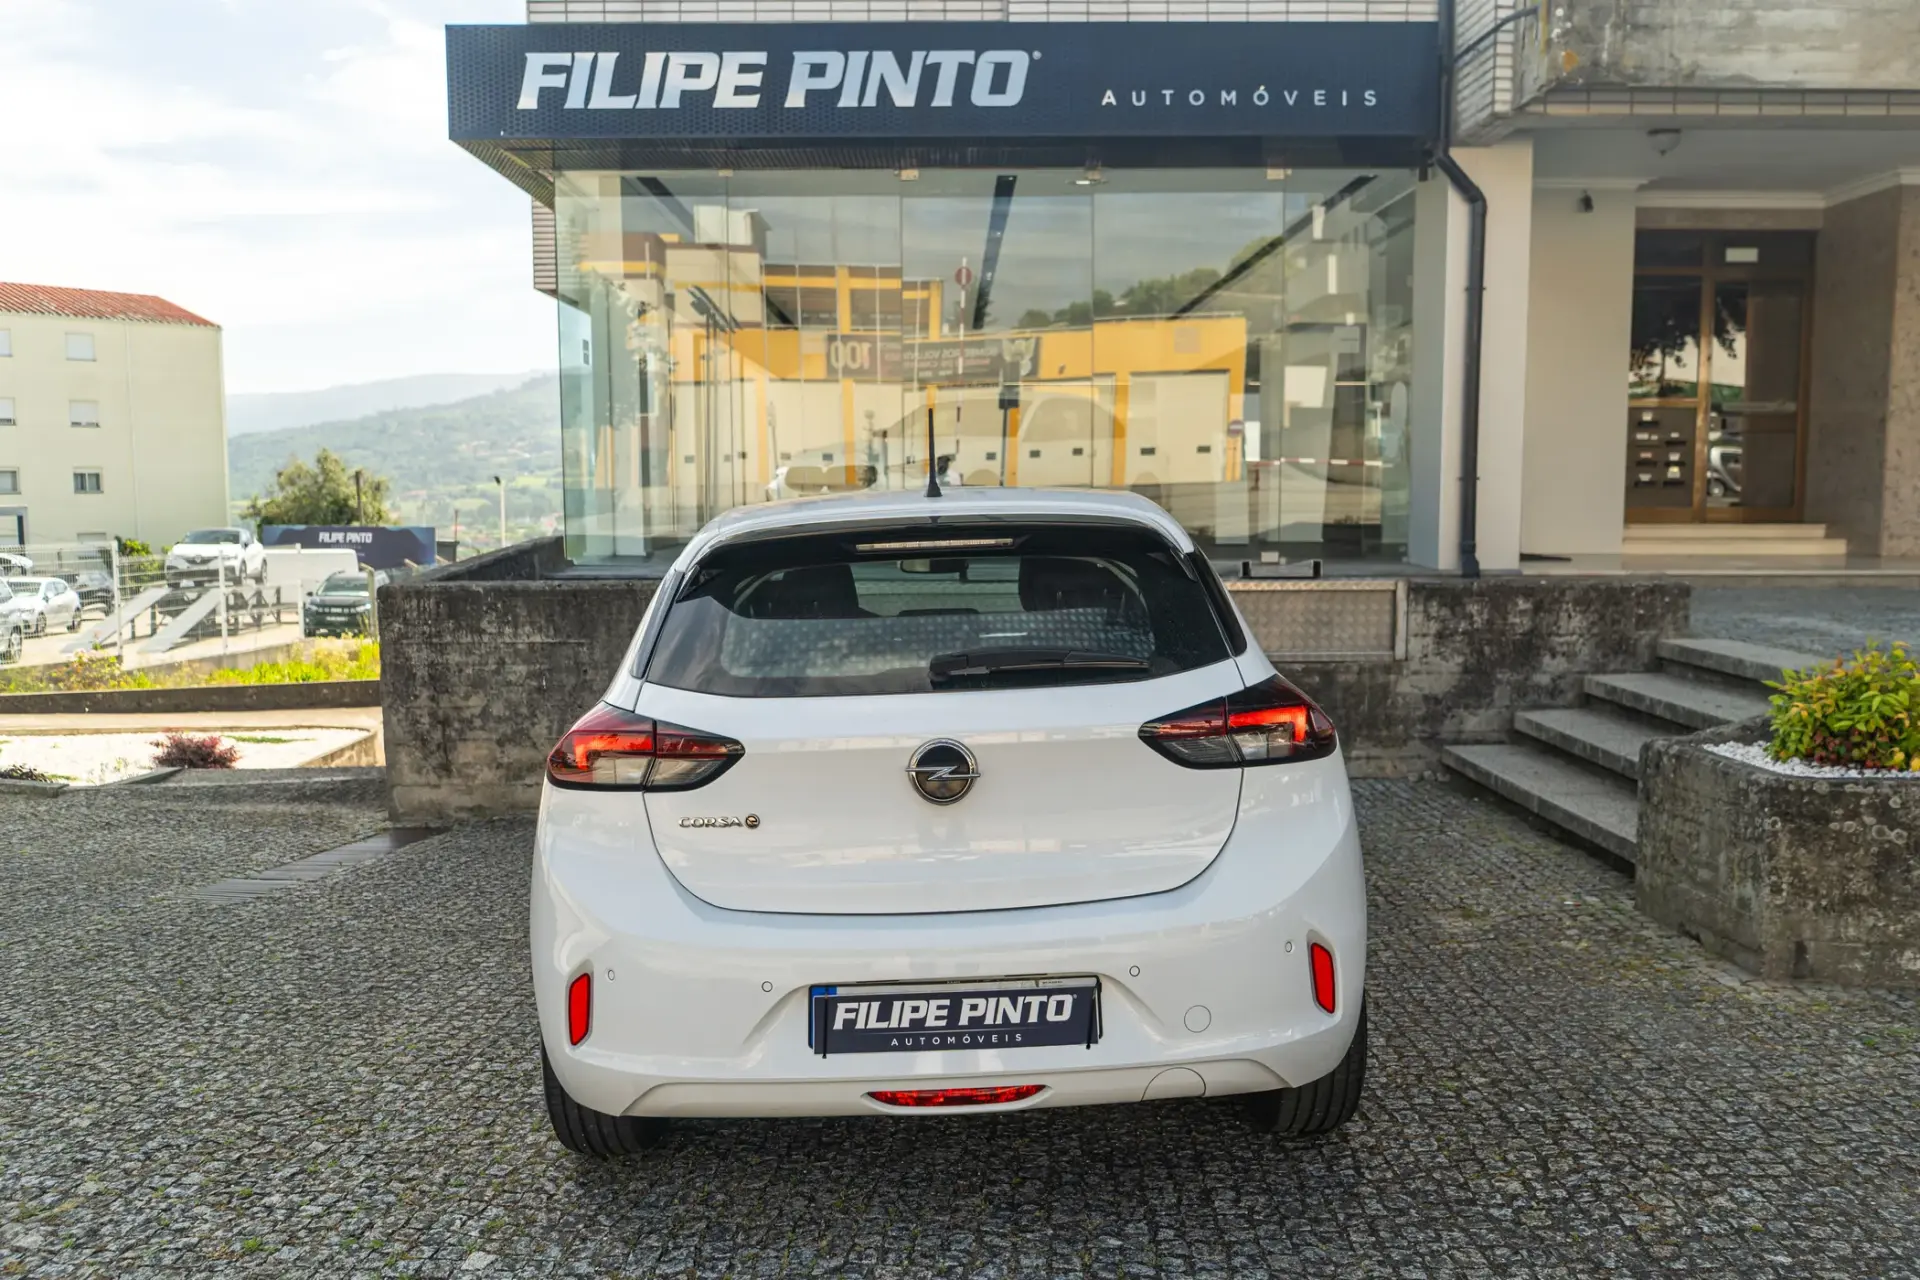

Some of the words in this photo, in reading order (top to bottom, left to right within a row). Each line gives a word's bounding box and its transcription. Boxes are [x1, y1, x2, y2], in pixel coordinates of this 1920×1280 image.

[516, 52, 768, 109] FILIPE
[784, 50, 1030, 107] PINTO
[1101, 85, 1377, 106] AUTOMÓVEIS
[319, 532, 345, 543] FILIPE
[346, 532, 372, 543] PINTO
[678, 816, 744, 828] CORSA
[833, 1000, 950, 1030] FILIPE
[958, 994, 1073, 1026] PINTO
[891, 1033, 1022, 1046] AUTOMÓVEIS
